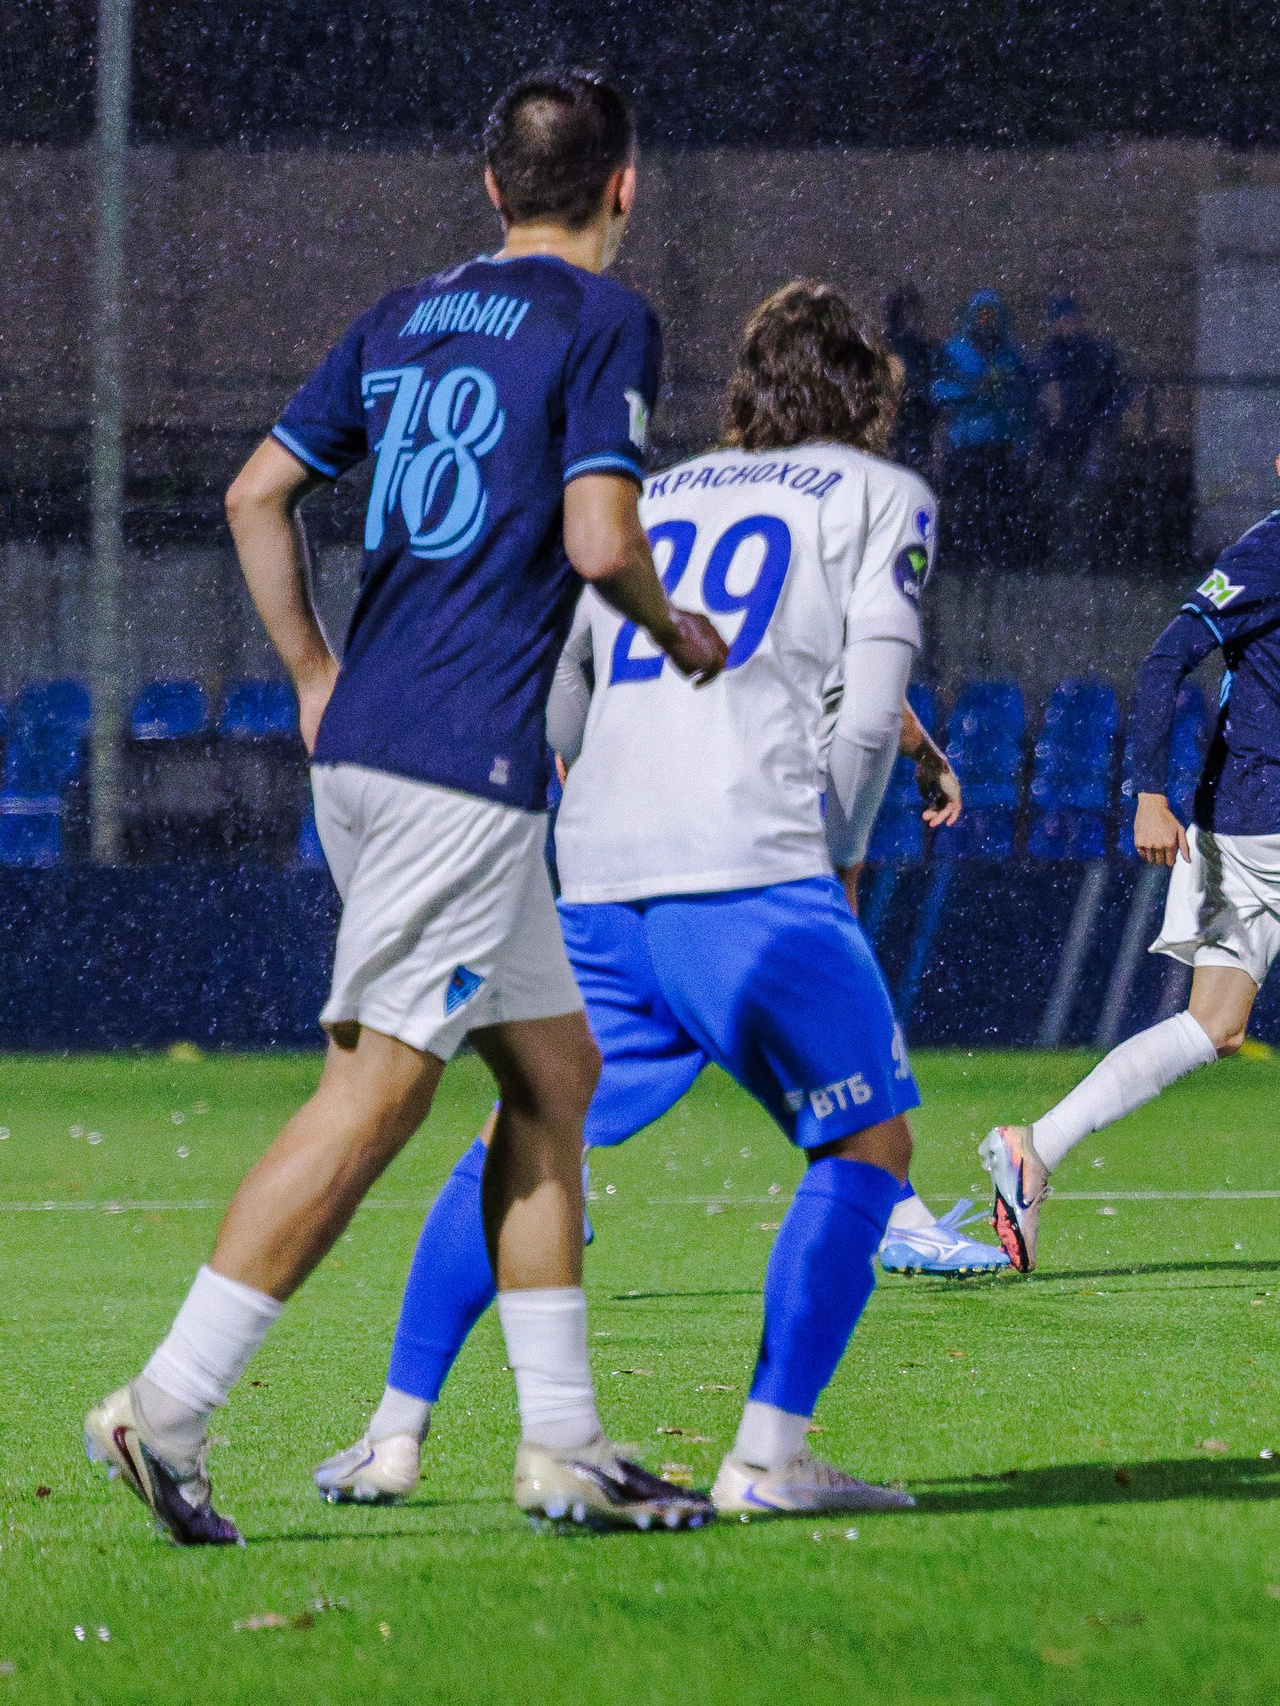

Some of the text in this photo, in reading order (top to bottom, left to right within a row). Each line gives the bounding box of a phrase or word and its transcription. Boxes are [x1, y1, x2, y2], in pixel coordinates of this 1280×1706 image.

[361, 362, 506, 560] 78
[647, 461, 843, 500] КРАСНОХОД
[608, 514, 792, 687] 29
[808, 1071, 874, 1120] ВТБ
